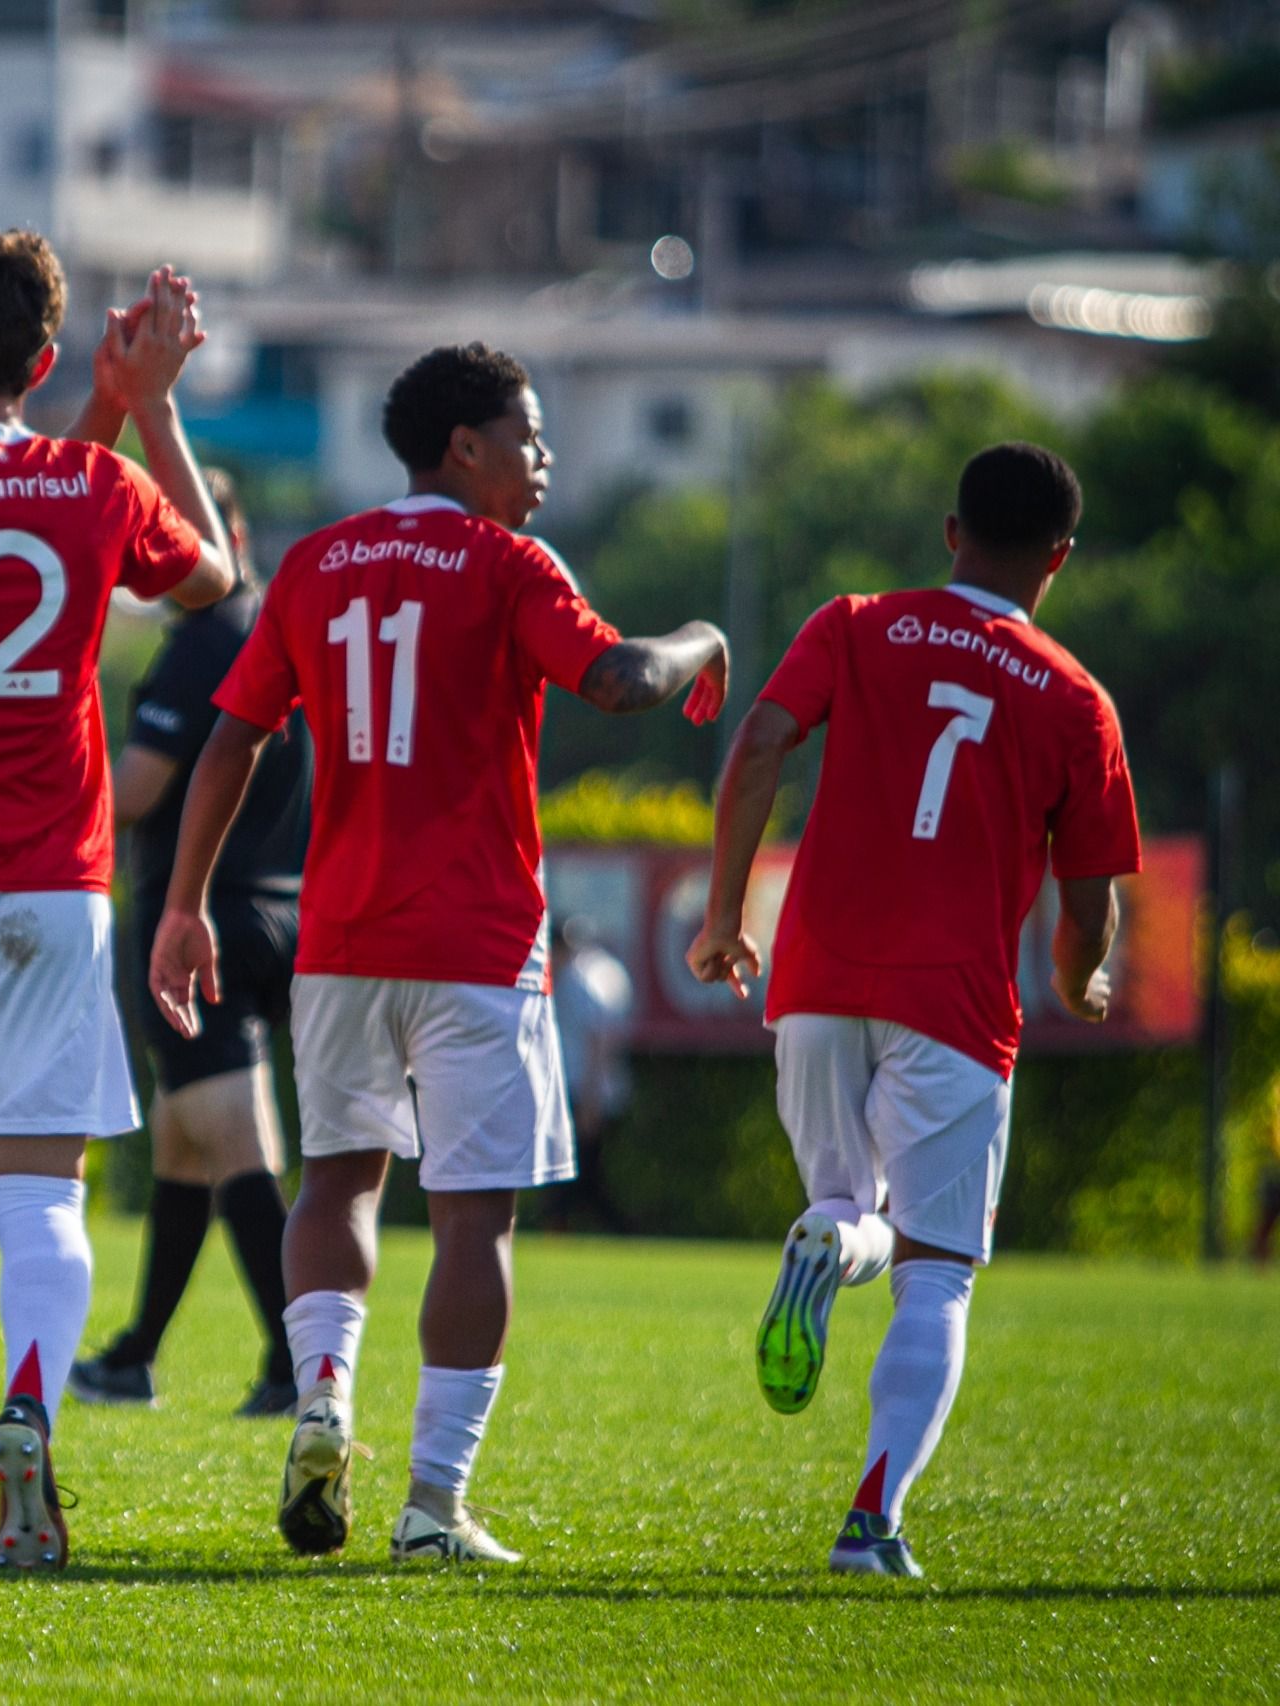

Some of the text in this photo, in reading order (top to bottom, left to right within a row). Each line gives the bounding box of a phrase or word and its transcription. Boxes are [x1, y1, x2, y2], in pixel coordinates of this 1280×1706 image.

[350, 539, 467, 572] banrisul
[327, 596, 423, 766] 11
[927, 620, 1051, 690] banrisul
[912, 680, 995, 839] 7
